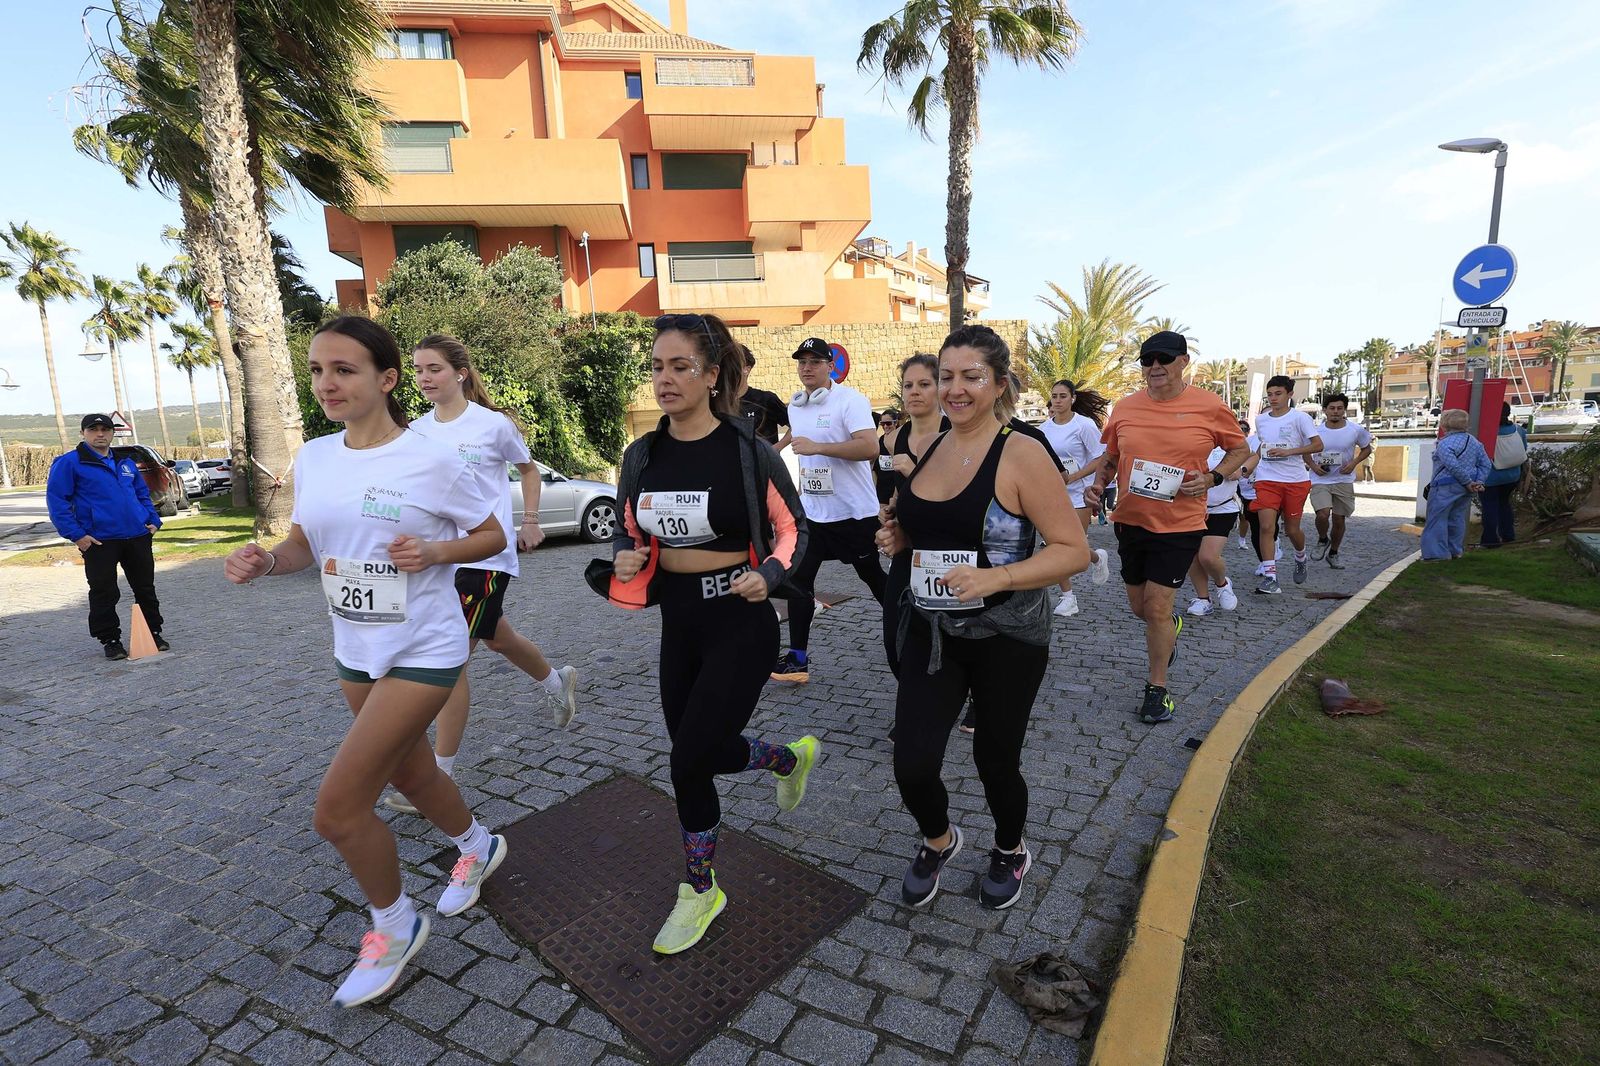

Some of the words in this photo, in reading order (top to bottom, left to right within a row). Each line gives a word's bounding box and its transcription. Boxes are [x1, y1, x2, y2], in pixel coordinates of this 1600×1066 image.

[1161, 466, 1181, 476] RUN
[807, 479, 822, 490] 199
[1144, 477, 1160, 491] 23
[364, 493, 377, 502] The
[675, 494, 701, 504] RUN
[362, 501, 401, 518] RUN
[657, 517, 689, 536] 130
[942, 553, 970, 563] RUN
[363, 563, 399, 575] RUN
[345, 578, 361, 586] MAYA
[341, 586, 374, 611] 261
